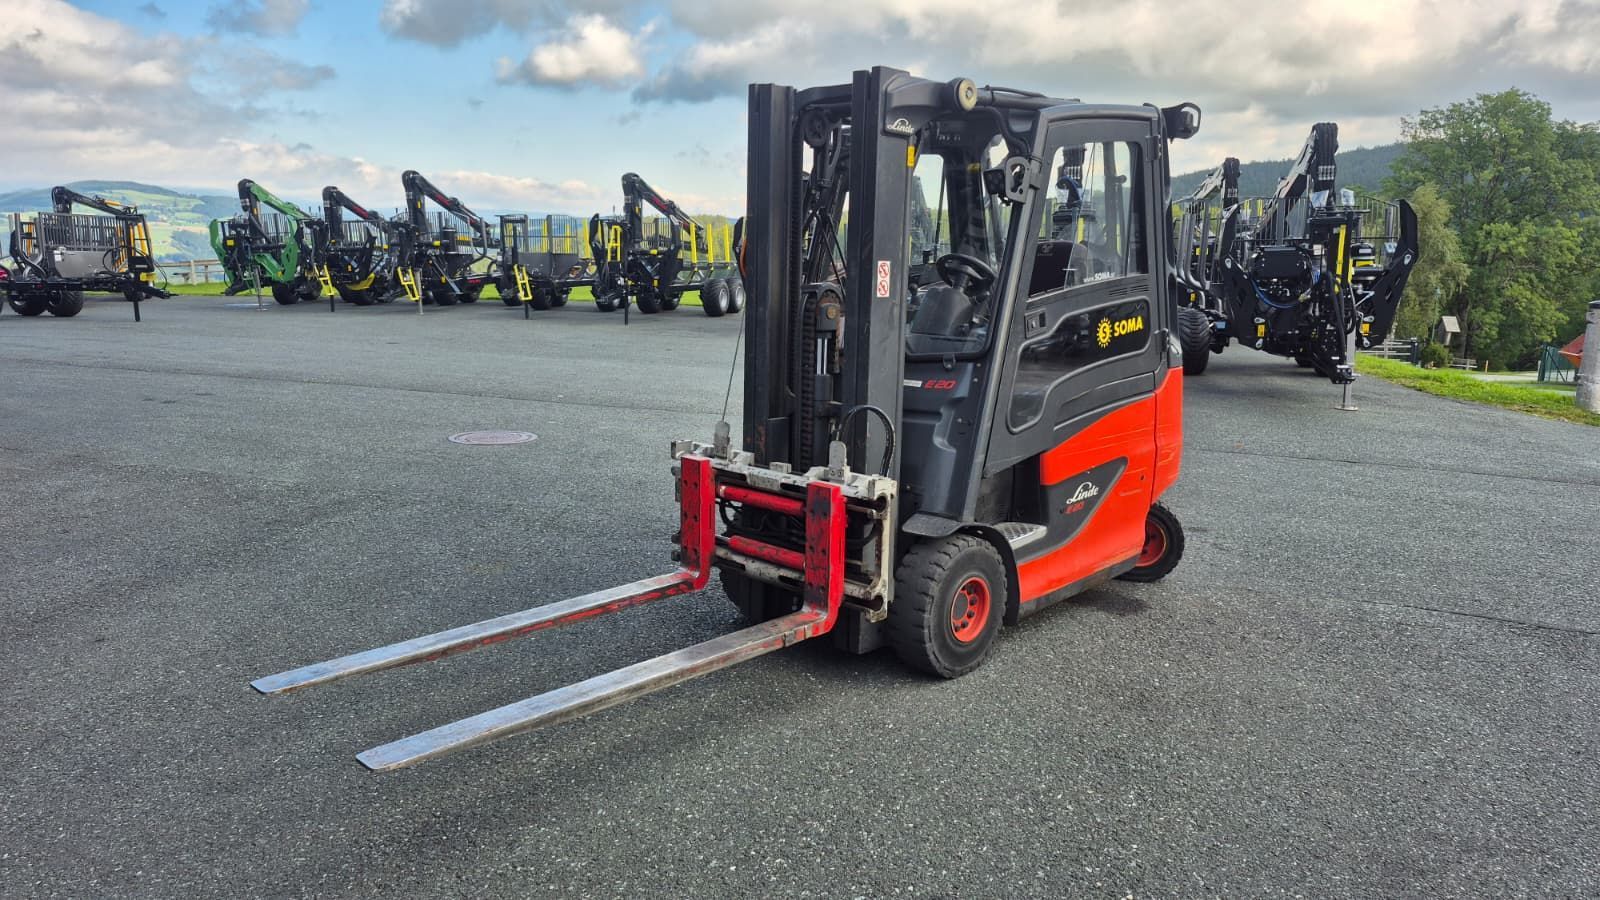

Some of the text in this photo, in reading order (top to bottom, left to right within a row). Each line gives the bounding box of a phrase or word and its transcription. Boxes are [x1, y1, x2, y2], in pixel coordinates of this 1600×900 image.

[887, 118, 914, 133] Linde
[1114, 316, 1143, 337] SOMA
[924, 379, 957, 390] E20
[1066, 481, 1099, 504] Linde
